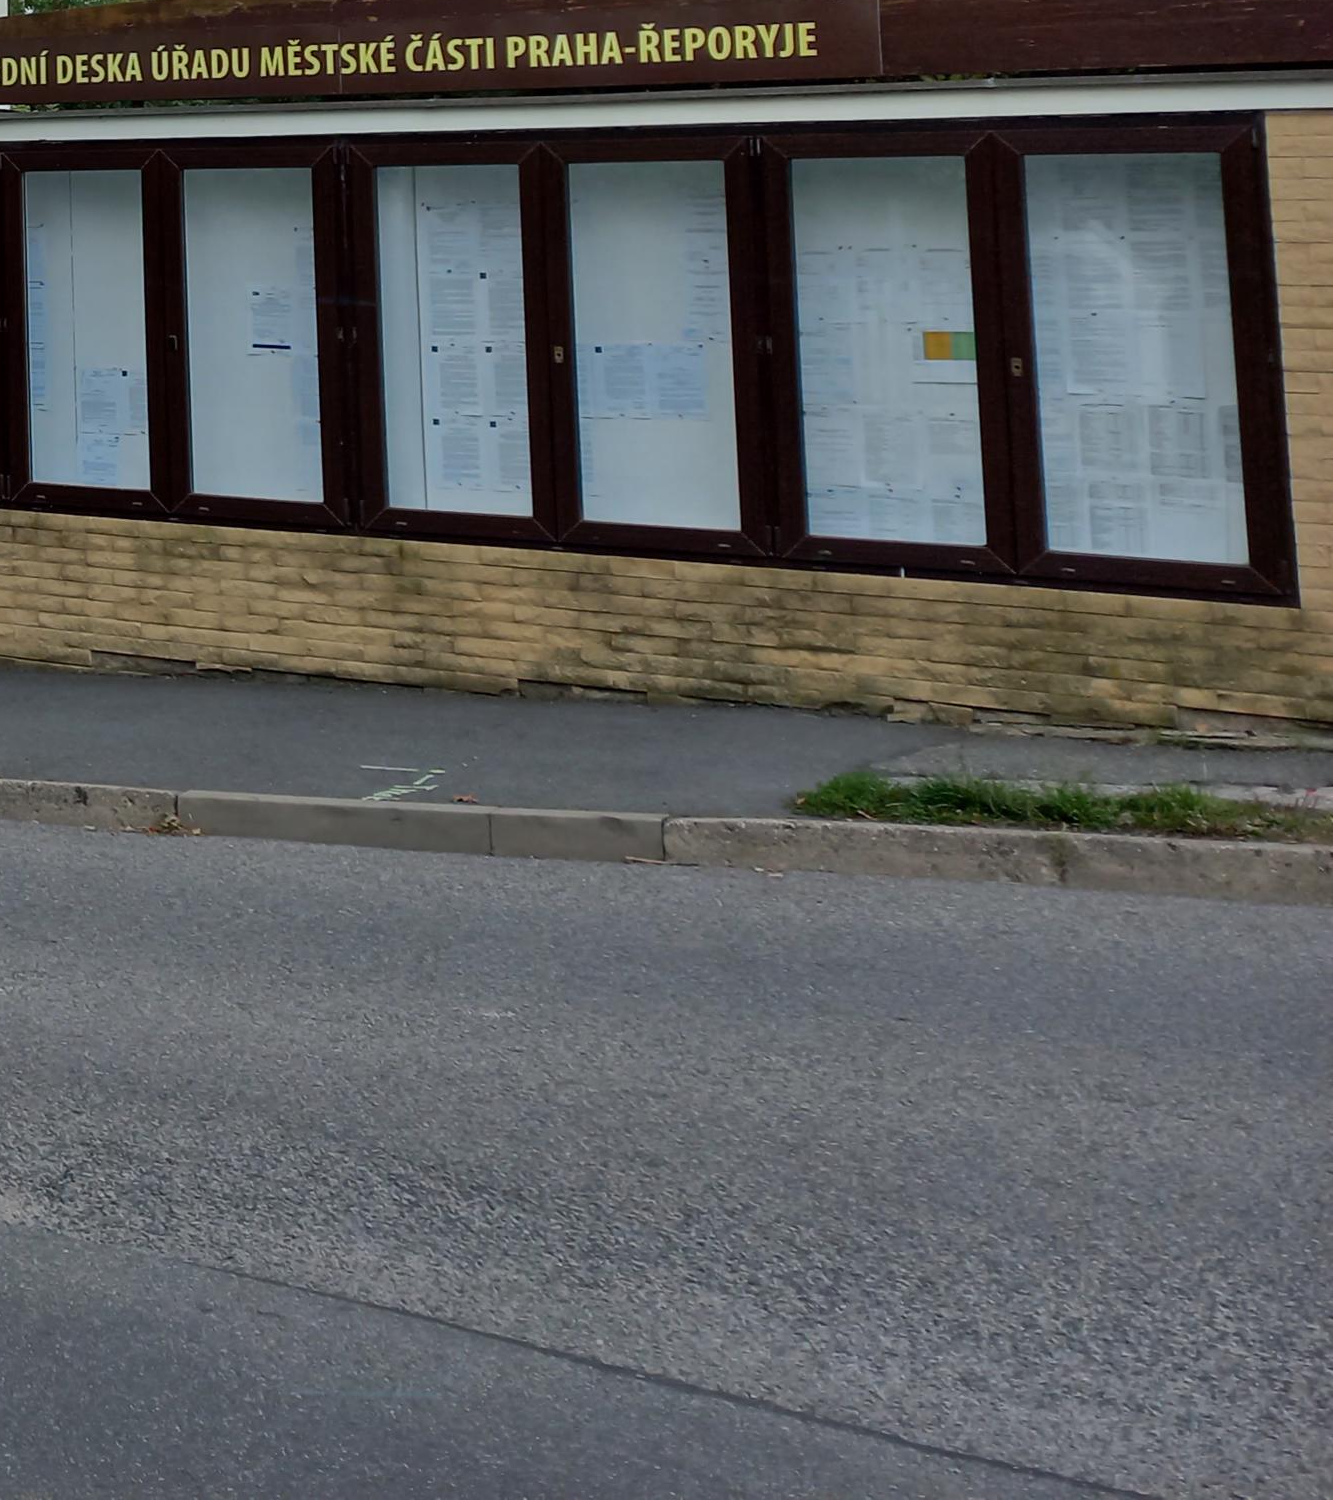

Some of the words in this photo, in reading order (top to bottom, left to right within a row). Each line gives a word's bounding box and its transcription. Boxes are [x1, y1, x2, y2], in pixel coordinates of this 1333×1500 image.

[55, 52, 143, 85] DESKA
[150, 43, 251, 82] ÚŘADU
[259, 36, 397, 78] MĚSTSKÉ
[404, 32, 495, 73] ČÁSTI
[505, 21, 819, 69] PRAHA-ŘEPORYJE
